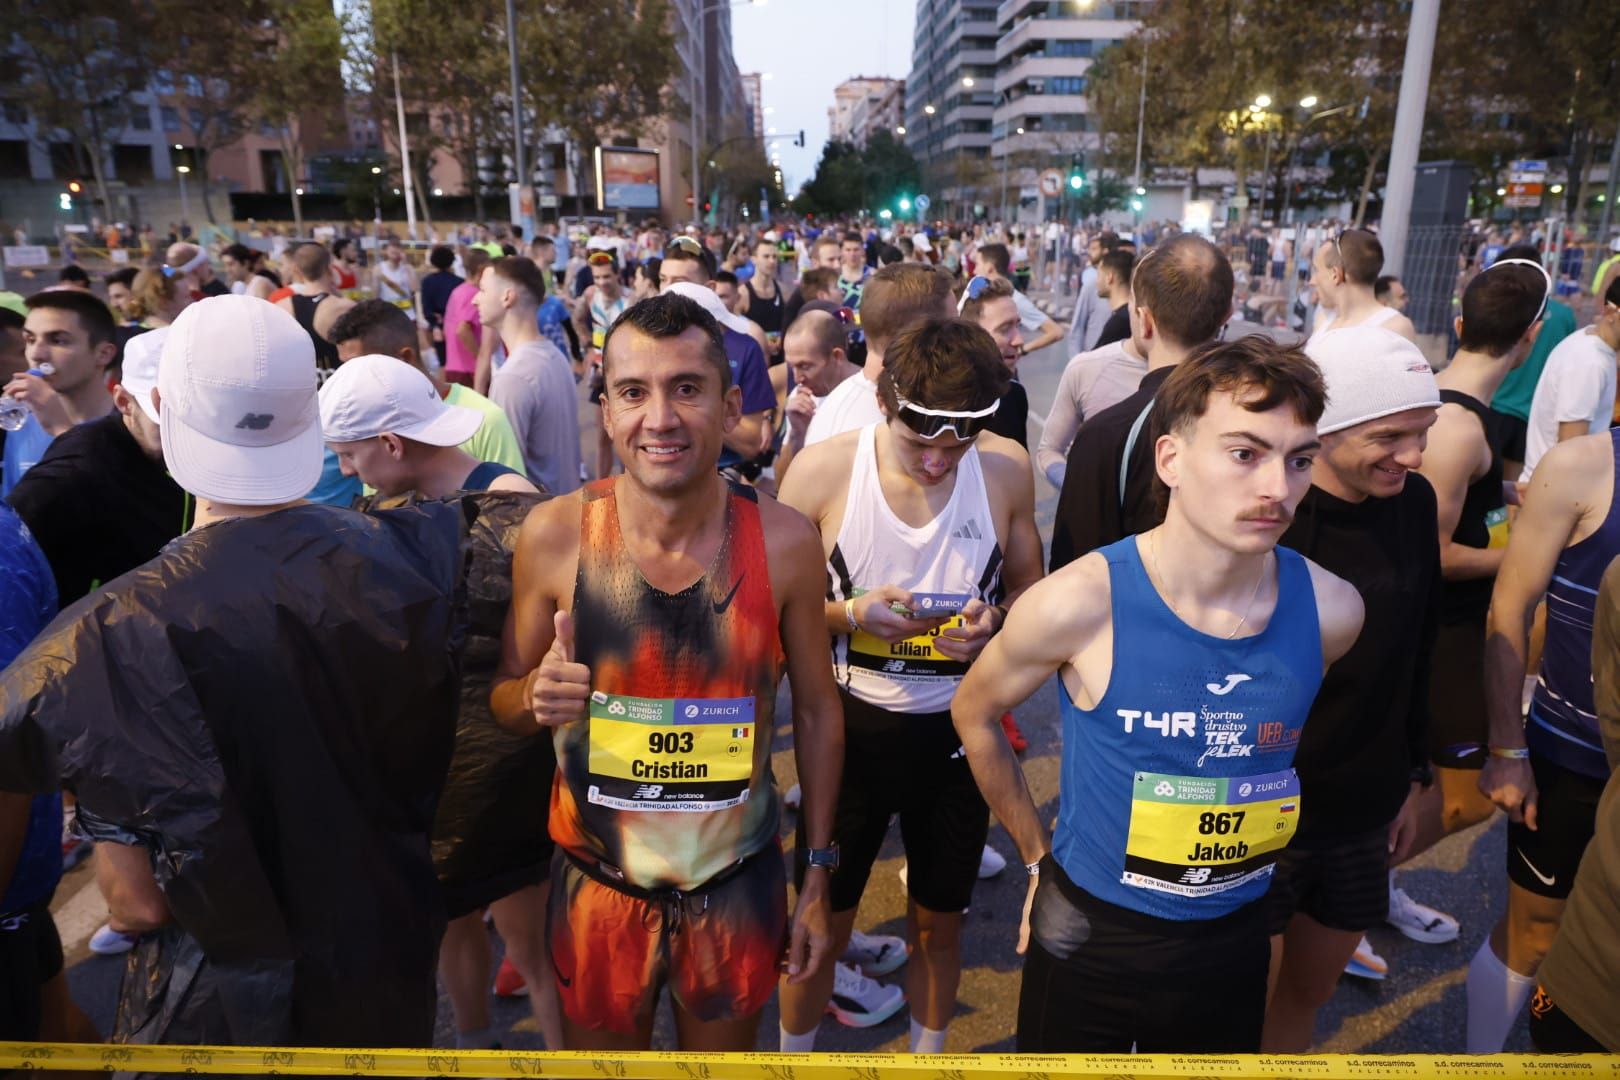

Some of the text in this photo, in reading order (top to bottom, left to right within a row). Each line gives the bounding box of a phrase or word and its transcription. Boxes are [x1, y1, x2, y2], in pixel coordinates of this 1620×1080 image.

[935, 600, 963, 608] ZURICH
[890, 641, 931, 656] Lilian
[628, 706, 663, 715] TRINIDAD
[628, 712, 663, 721] ALFONSO
[702, 706, 739, 716] ZURICH
[1200, 705, 1244, 721] Športno
[1116, 709, 1196, 738] T4R
[1205, 720, 1247, 732] društvo
[649, 732, 694, 754] 903
[1205, 732, 1243, 745] TEK
[631, 759, 708, 779] Cristian
[1178, 786, 1216, 795] TRINIDAD
[1255, 779, 1288, 793] ZURICH
[1177, 793, 1215, 801] ALFONSO
[640, 802, 670, 810] TRINIDAD
[672, 802, 703, 810] ALFONSO
[1198, 811, 1246, 835] 867
[1188, 841, 1248, 862] Jakob
[1156, 881, 1184, 893] VALENCIA
[1185, 886, 1216, 895] TRINIDAD
[1538, 1062, 1592, 1070] correcaminos
